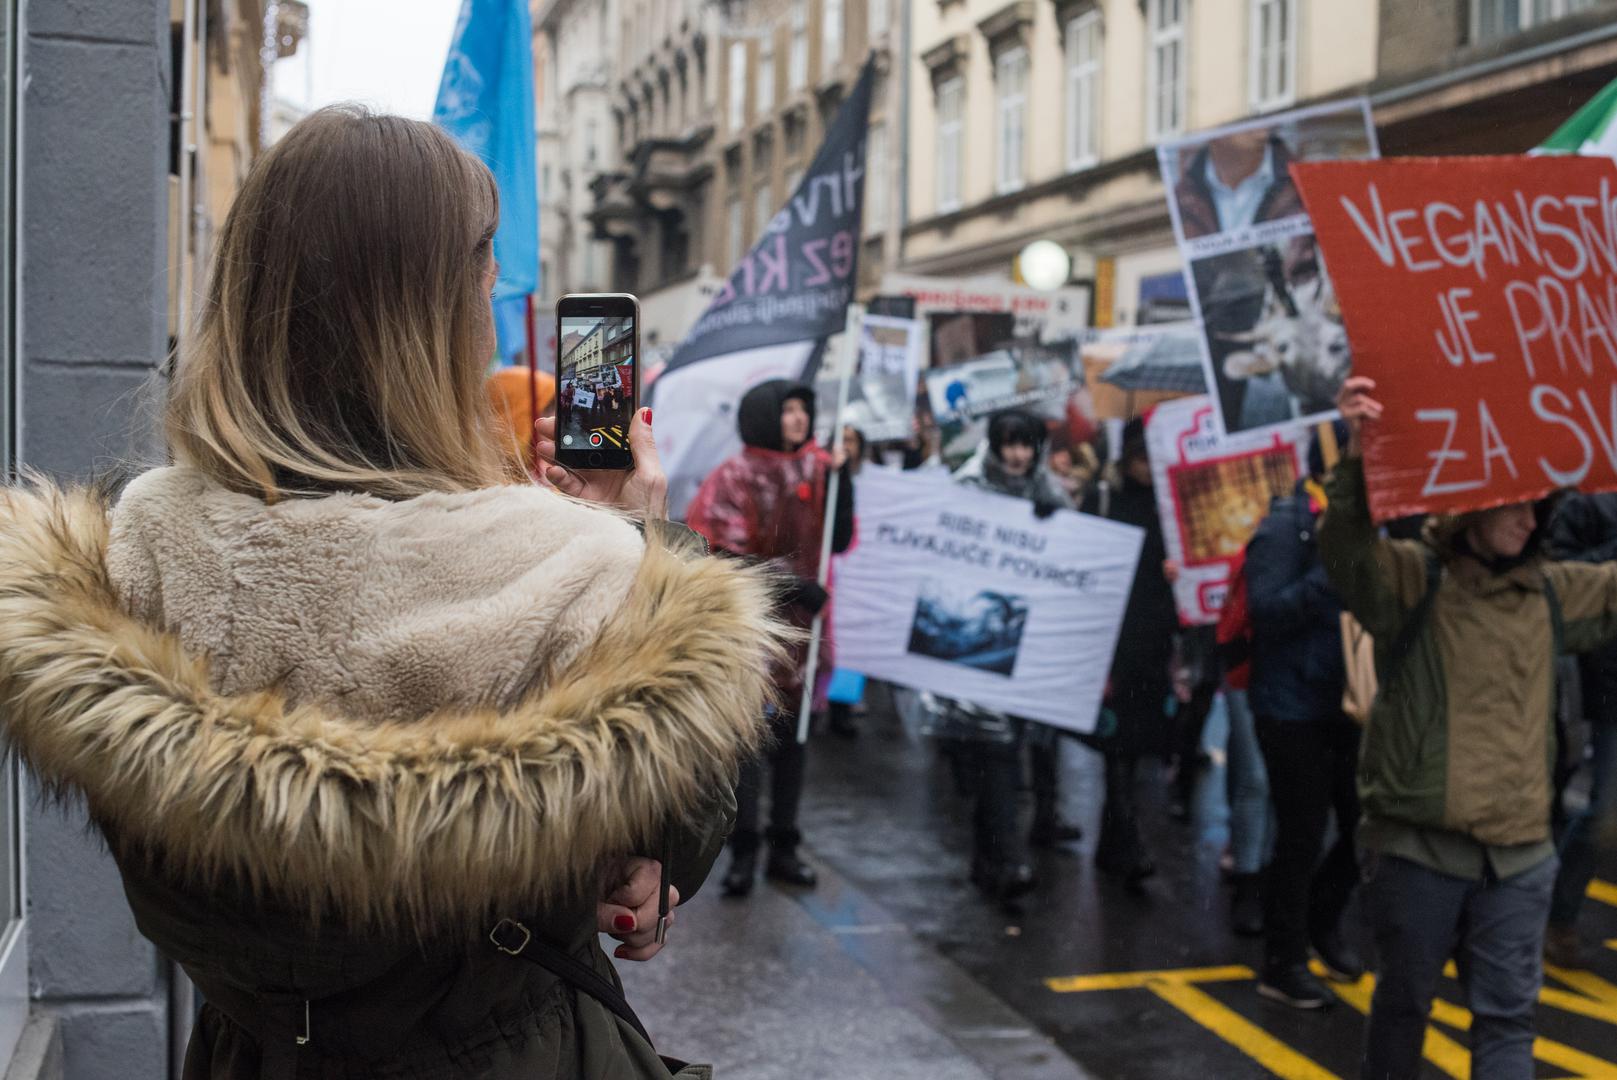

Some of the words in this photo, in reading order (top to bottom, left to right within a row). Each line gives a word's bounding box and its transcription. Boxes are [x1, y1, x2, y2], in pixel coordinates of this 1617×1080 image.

[1339, 176, 1617, 282] VEGANSTV
[1435, 287, 1495, 367] JE
[1505, 274, 1617, 379] PRAV
[1414, 399, 1518, 496] ZA
[1530, 382, 1617, 486] SV
